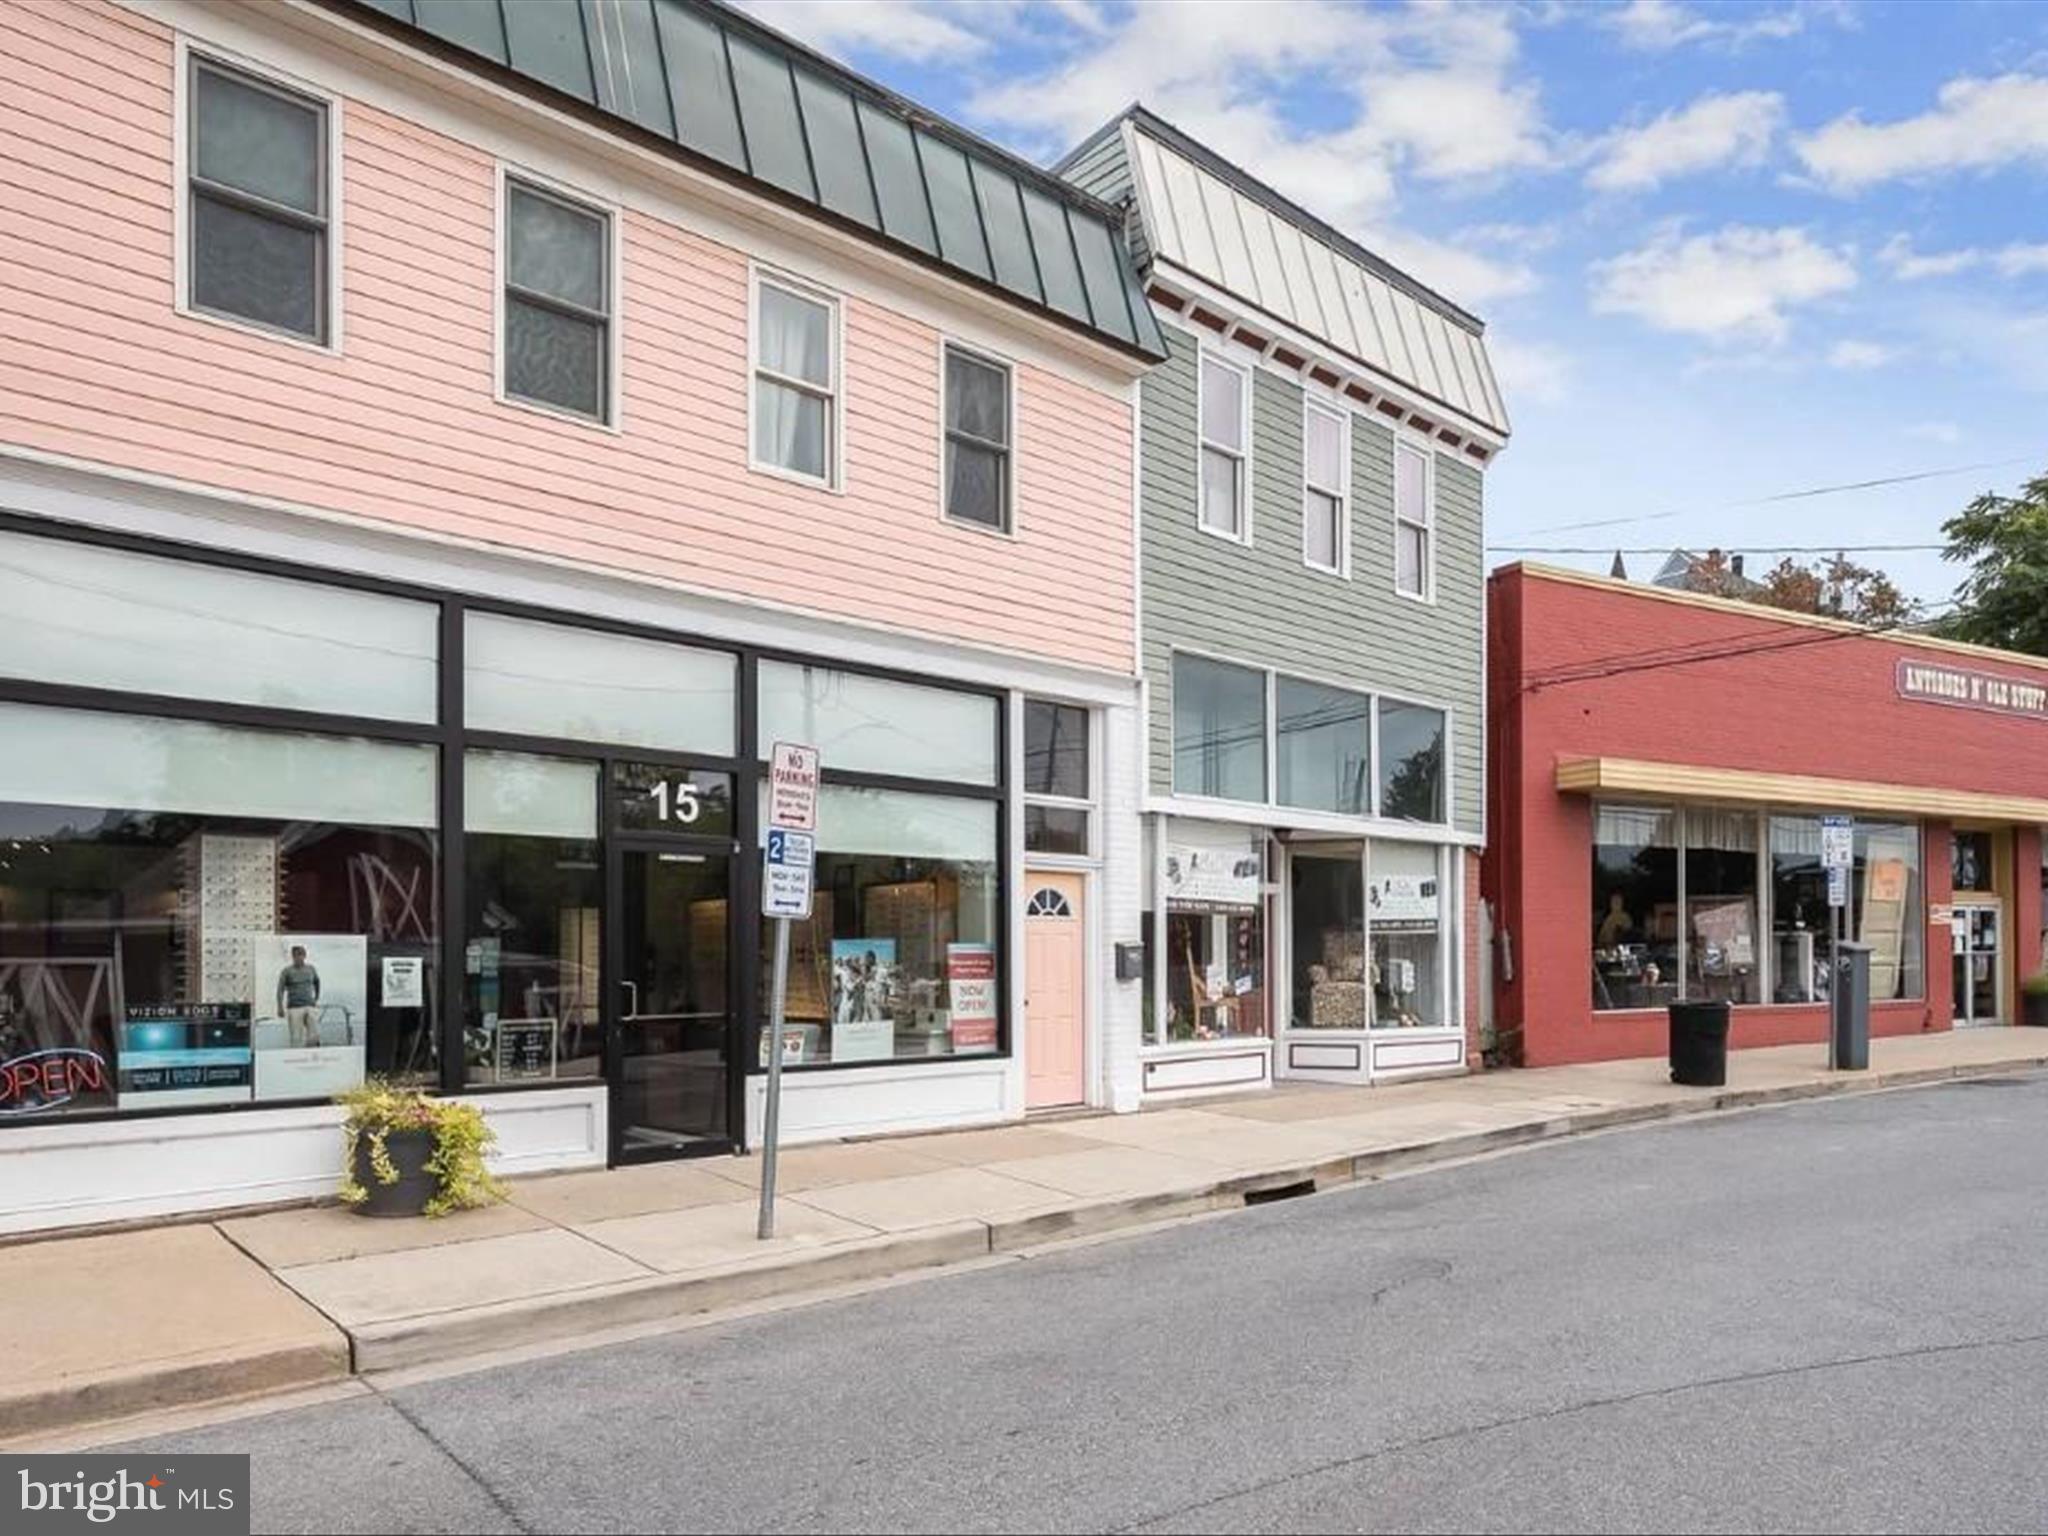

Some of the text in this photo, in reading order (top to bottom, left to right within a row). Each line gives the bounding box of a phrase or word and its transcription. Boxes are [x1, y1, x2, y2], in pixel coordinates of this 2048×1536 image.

[775, 768, 814, 789] PARKING
[650, 780, 699, 823] 15
[770, 836, 782, 859] 2
